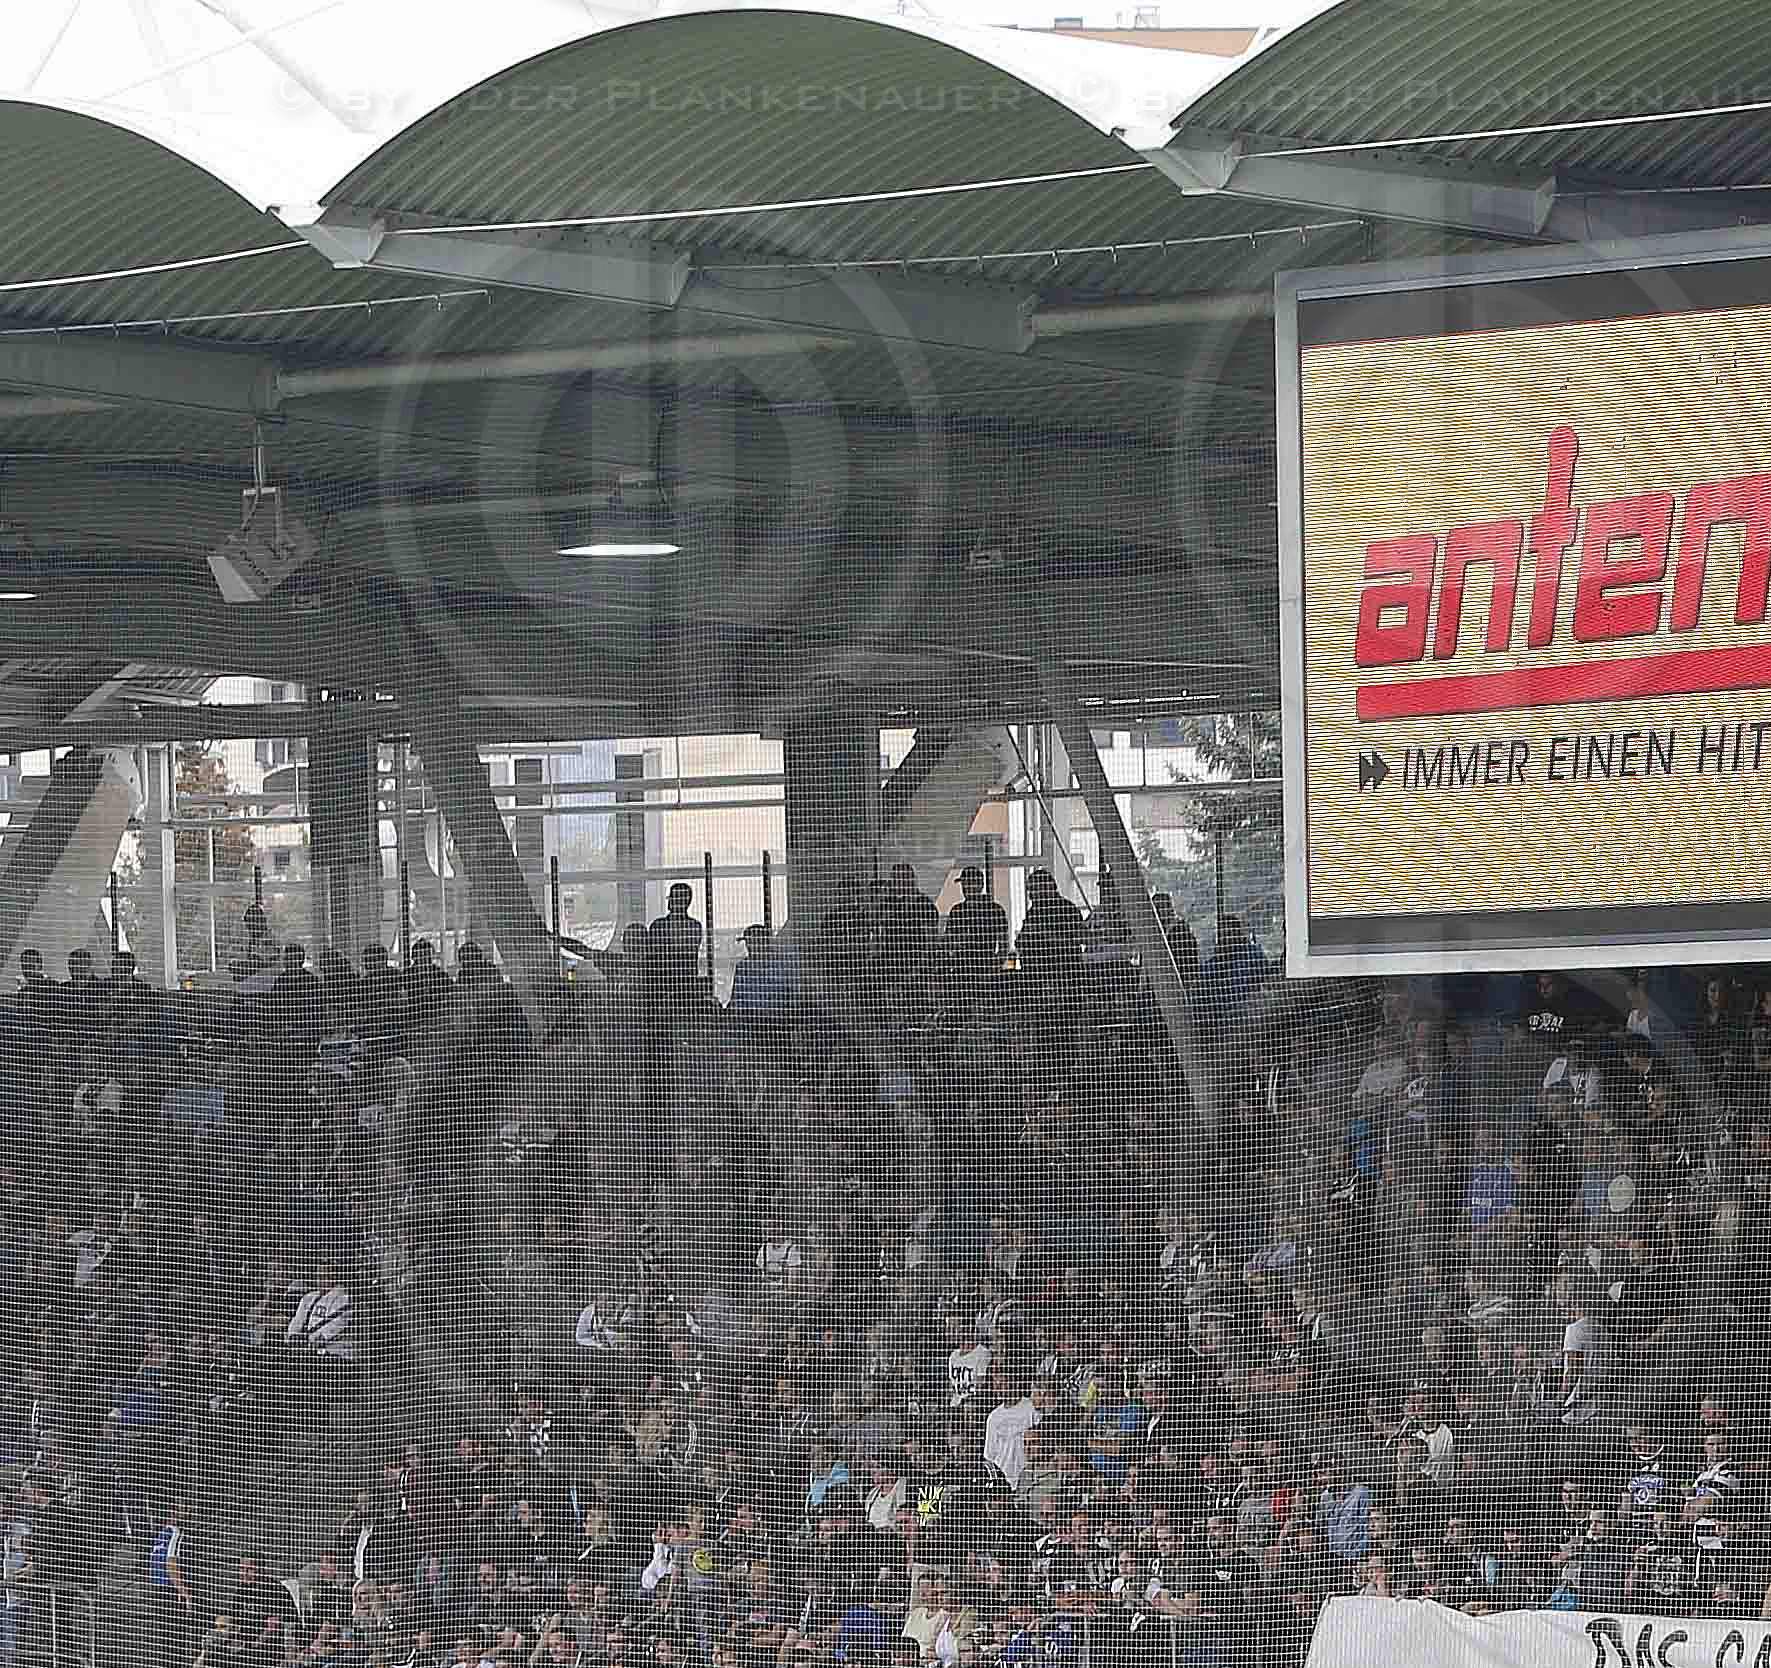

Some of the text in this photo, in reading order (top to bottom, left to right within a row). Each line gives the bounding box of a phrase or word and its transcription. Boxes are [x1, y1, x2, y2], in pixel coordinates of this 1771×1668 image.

[1401, 740, 1530, 790] IMMER
[1547, 729, 1675, 780] EINEN
[1697, 720, 1771, 772] HIT
